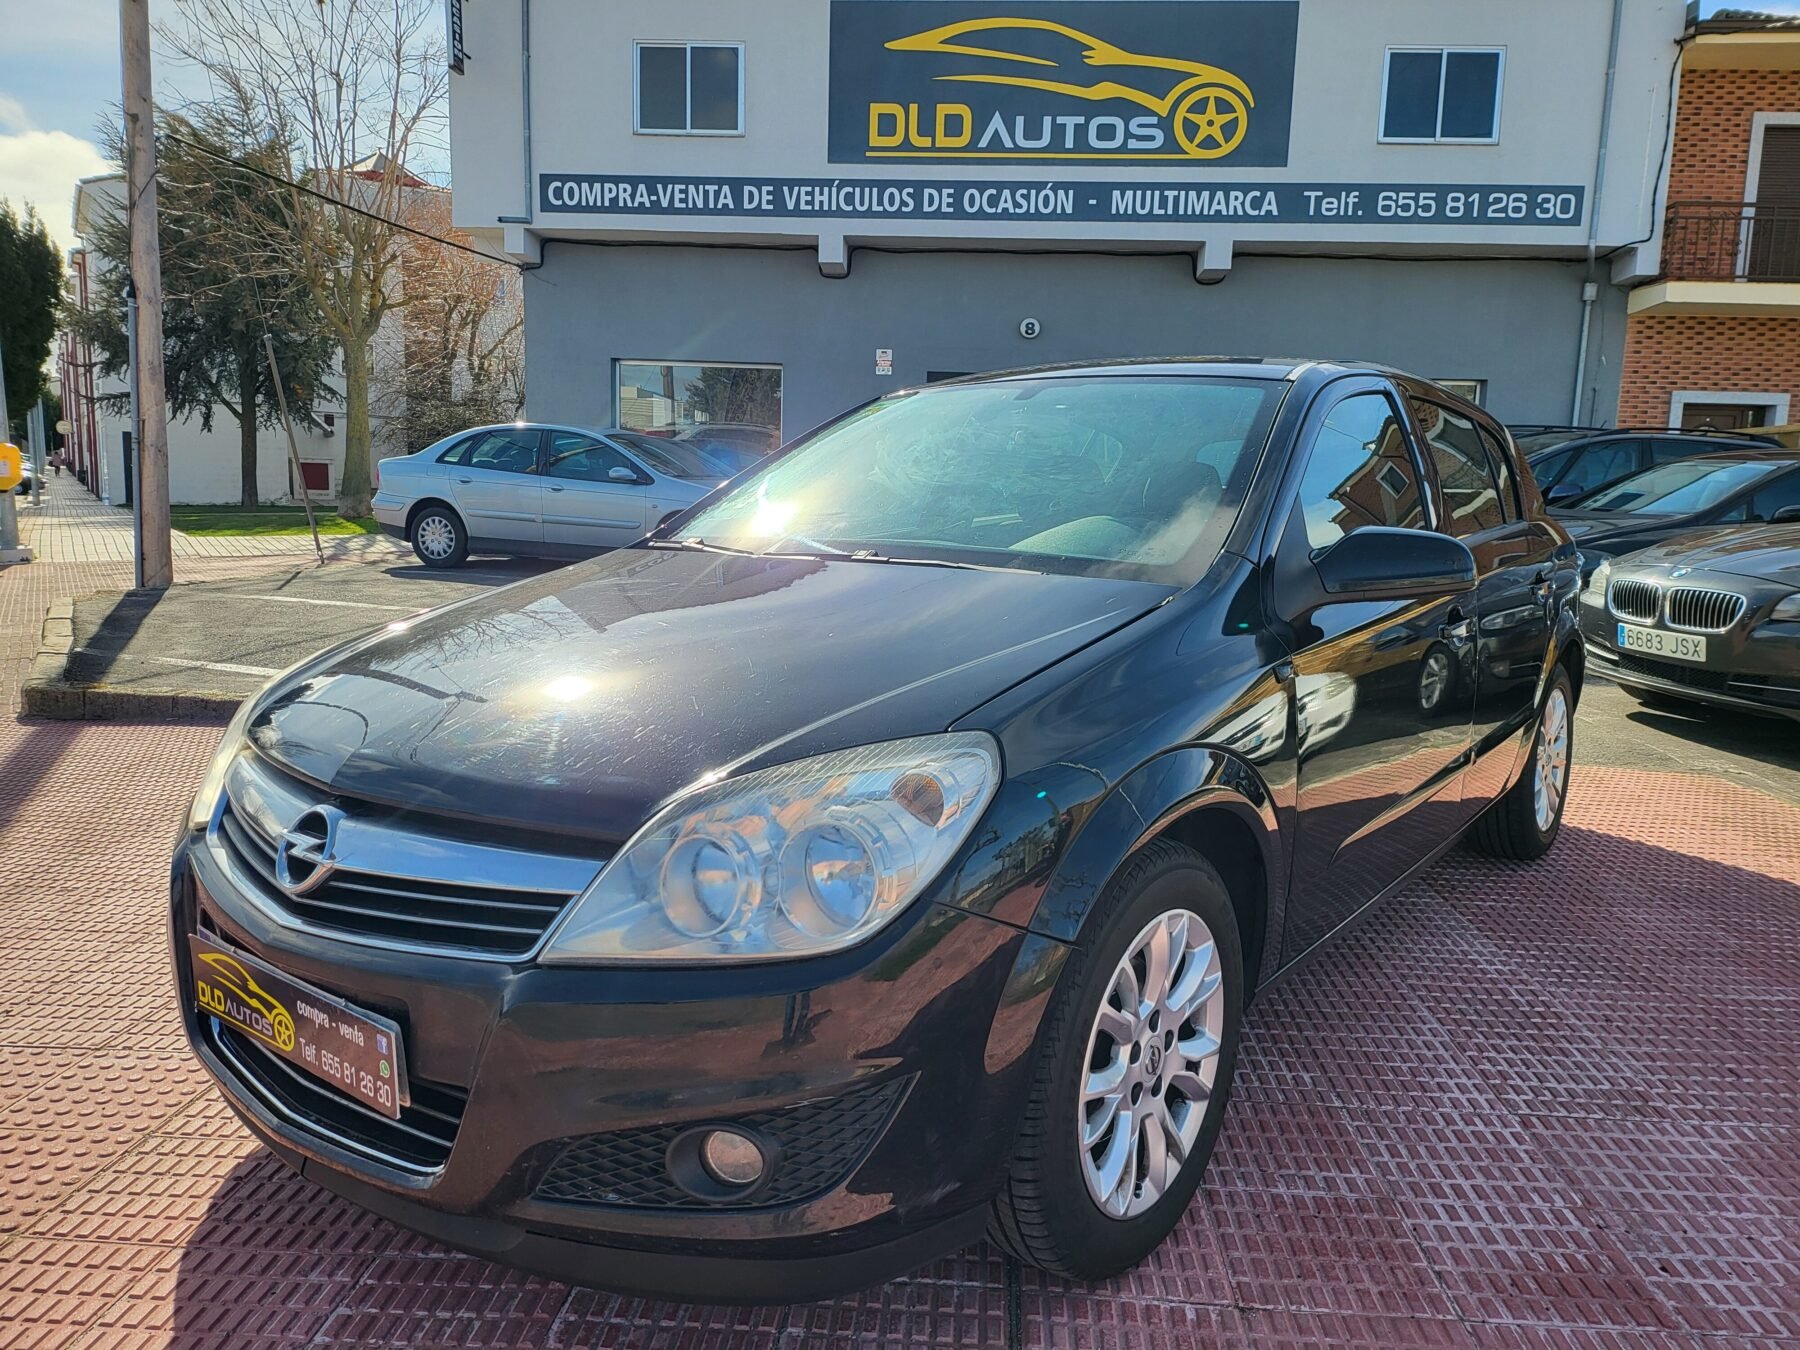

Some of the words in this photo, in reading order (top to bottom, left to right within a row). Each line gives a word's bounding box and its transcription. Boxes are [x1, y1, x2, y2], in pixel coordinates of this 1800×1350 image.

[868, 102, 973, 148] DLD
[977, 110, 1165, 150] AUTOS
[547, 181, 735, 209] COMPRA-VENTA
[743, 185, 774, 210] DE
[783, 180, 914, 212] VEHÍCULOS
[922, 187, 955, 213] DE
[963, 183, 1074, 214] OCASIÓN
[1111, 190, 1279, 216] MULTIMARCA
[1304, 191, 1363, 216] Telf.
[1377, 191, 1437, 217] 655
[1445, 192, 1480, 218] 81
[1487, 193, 1528, 218] 26
[1535, 193, 1576, 219] 30
[1024, 322, 1036, 336] 8
[1627, 629, 1663, 651] 6683
[1670, 637, 1701, 658] JSX
[198, 980, 225, 1012] DLD
[225, 999, 273, 1037] AUTOS
[297, 1000, 330, 1029] compra
[338, 1021, 365, 1047] venta
[299, 1037, 319, 1066] Telf.
[321, 1049, 341, 1078] 655
[343, 1065, 357, 1087] 81
[360, 1071, 375, 1097] 26
[377, 1080, 391, 1108] 30
